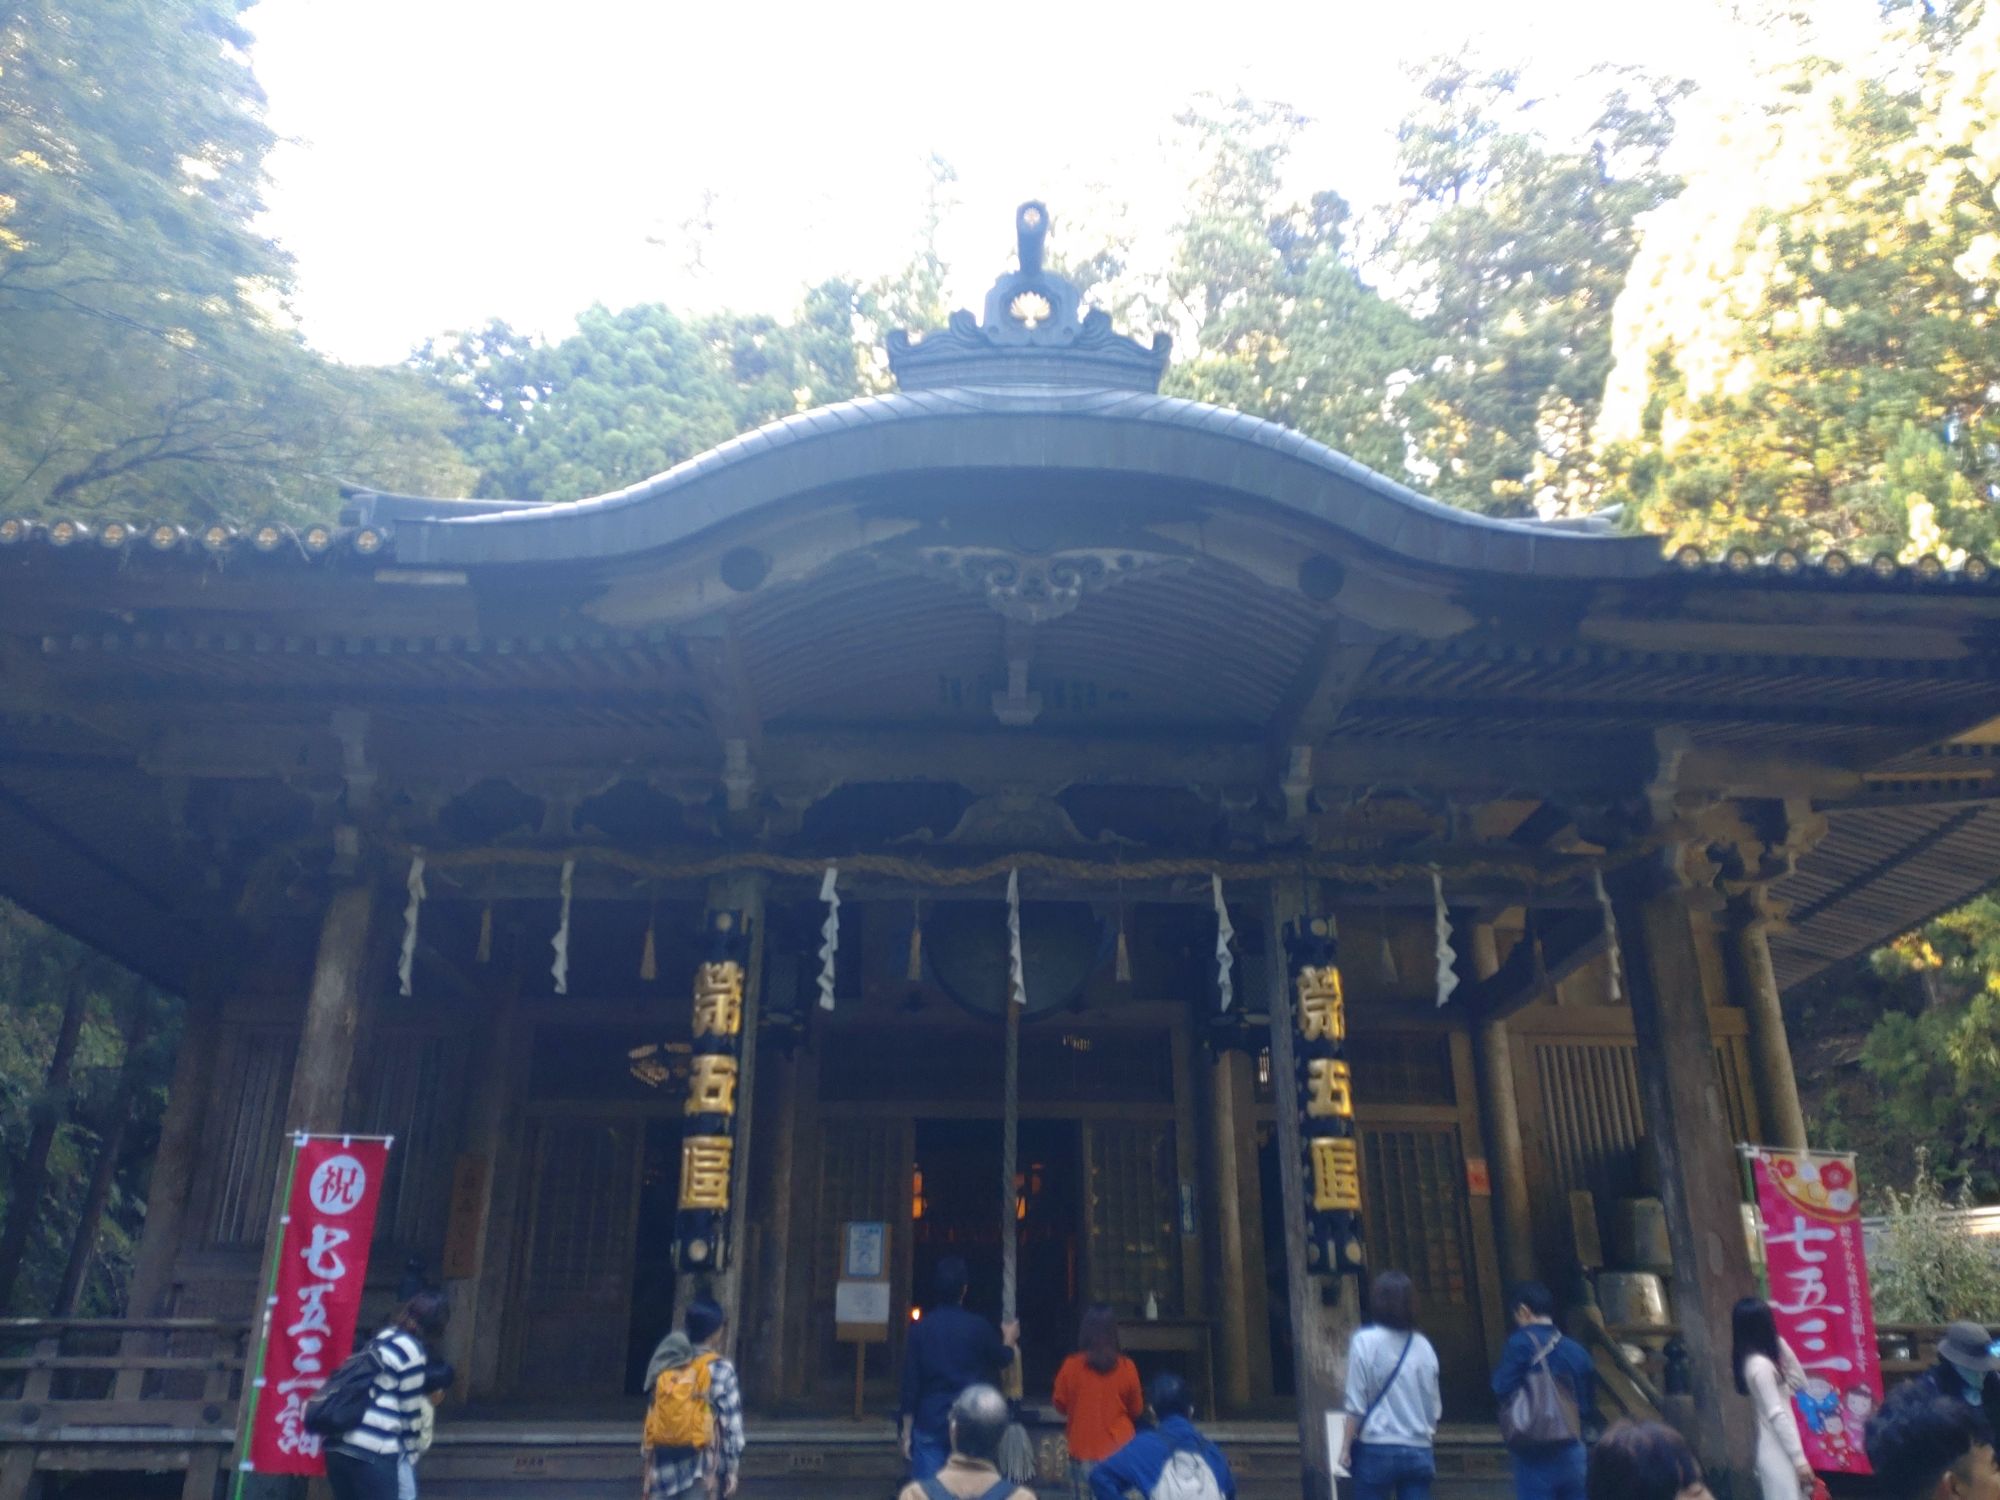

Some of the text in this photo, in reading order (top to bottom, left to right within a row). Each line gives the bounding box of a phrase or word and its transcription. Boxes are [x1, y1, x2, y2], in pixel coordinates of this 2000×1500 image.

[318, 1165, 358, 1205] 祝
[1765, 1216, 1853, 1372] 七五三
